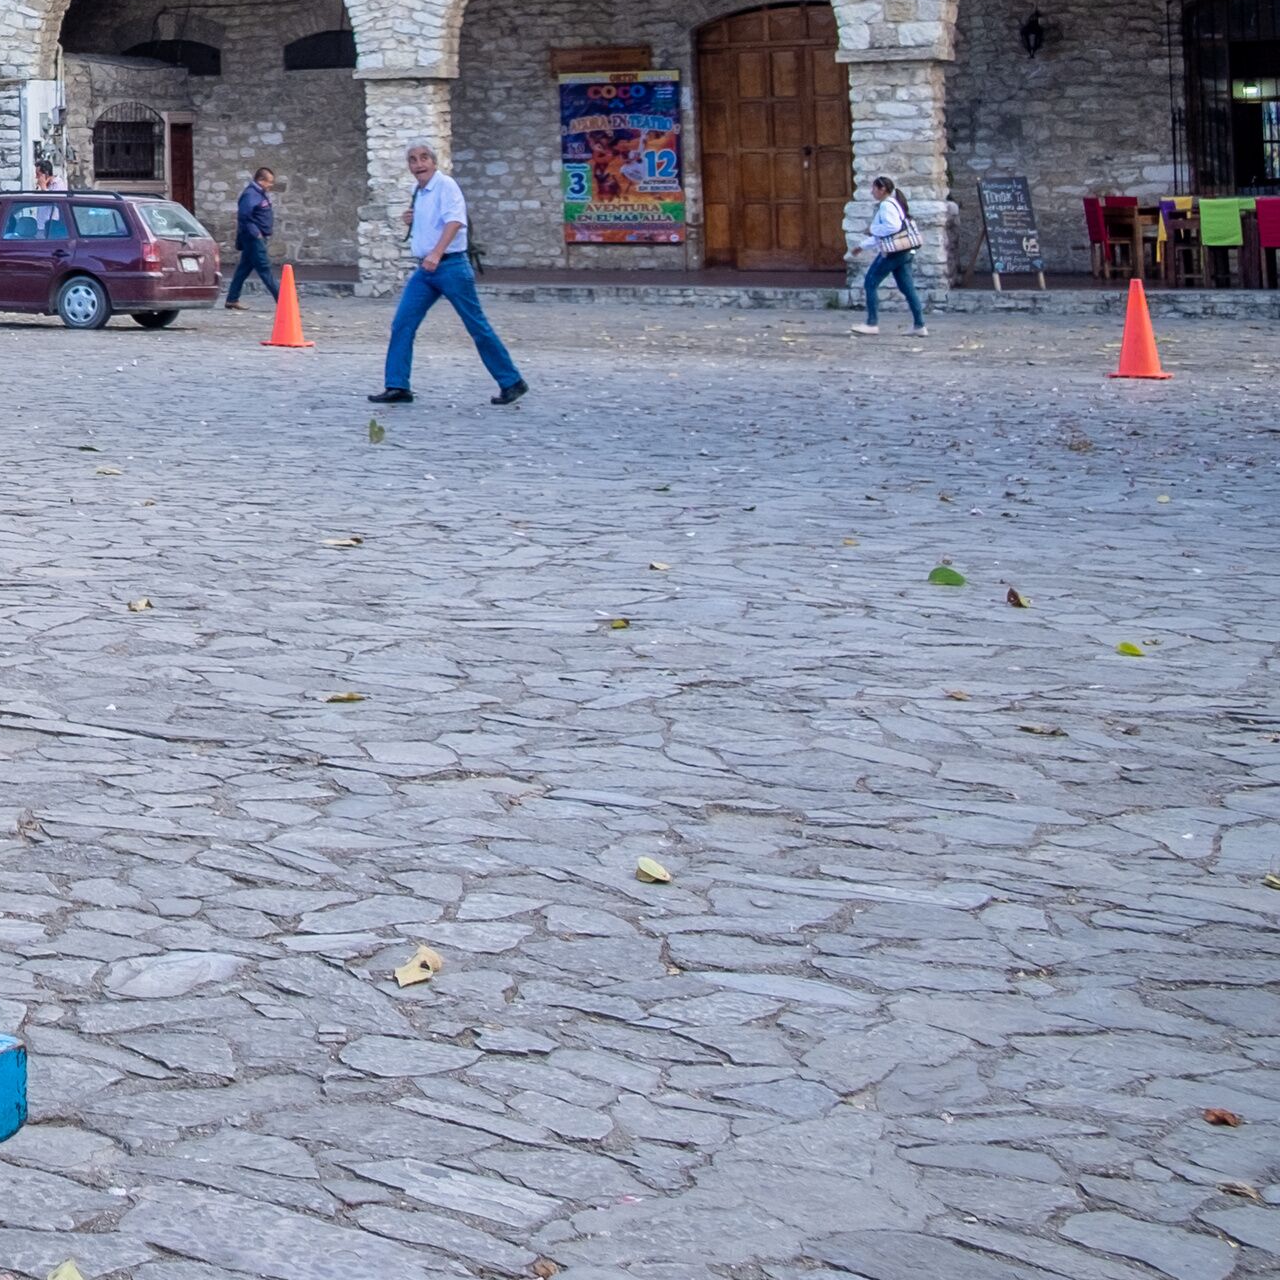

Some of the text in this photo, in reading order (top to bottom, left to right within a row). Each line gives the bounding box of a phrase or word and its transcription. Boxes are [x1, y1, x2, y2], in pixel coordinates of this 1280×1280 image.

[587, 85, 646, 99] COCO
[644, 149, 679, 178] 12
[568, 171, 588, 196] 3
[585, 204, 660, 213] AVENTURA
[596, 214, 611, 222] EL
